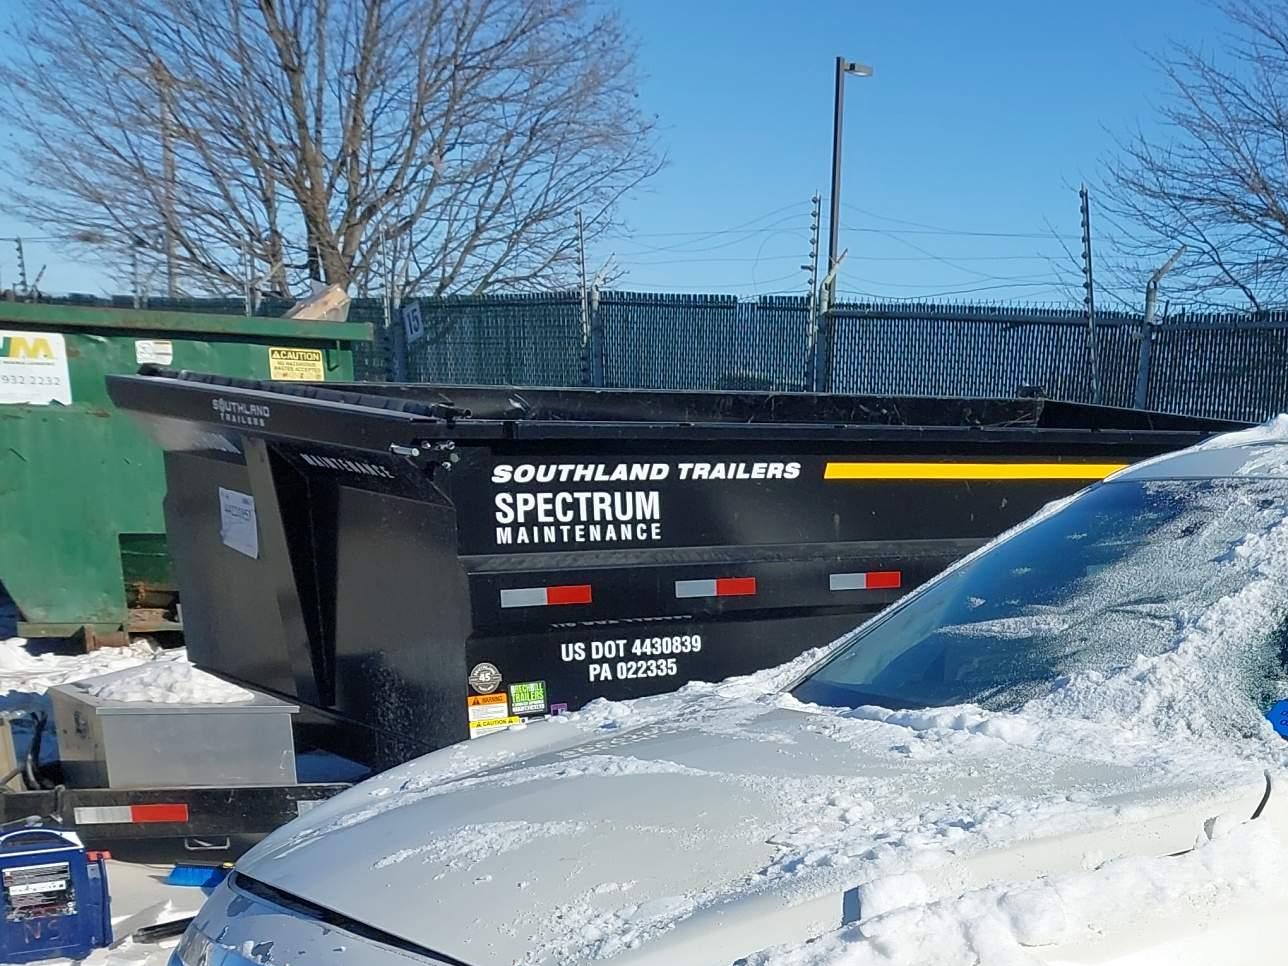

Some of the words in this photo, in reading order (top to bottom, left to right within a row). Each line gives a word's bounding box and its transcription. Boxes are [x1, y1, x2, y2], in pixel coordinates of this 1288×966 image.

[407, 308, 420, 335] 15
[280, 350, 320, 361] CAUTION
[212, 398, 270, 418] SOUTHLAND
[220, 413, 265, 427] TRAILERS
[300, 453, 396, 479] MAINTENANCE
[491, 463, 670, 483] SOUTHLAND
[677, 462, 801, 480] TRAILERS
[495, 491, 661, 524] SPECTRUM
[496, 523, 662, 544] MAINTENANCE
[561, 642, 586, 662] US
[591, 639, 627, 659] DOT
[631, 635, 702, 656] 4430839
[588, 663, 613, 682] PA
[616, 658, 677, 679] 022335
[512, 690, 544, 703] TRAILERS
[482, 718, 507, 727] CAUTION
